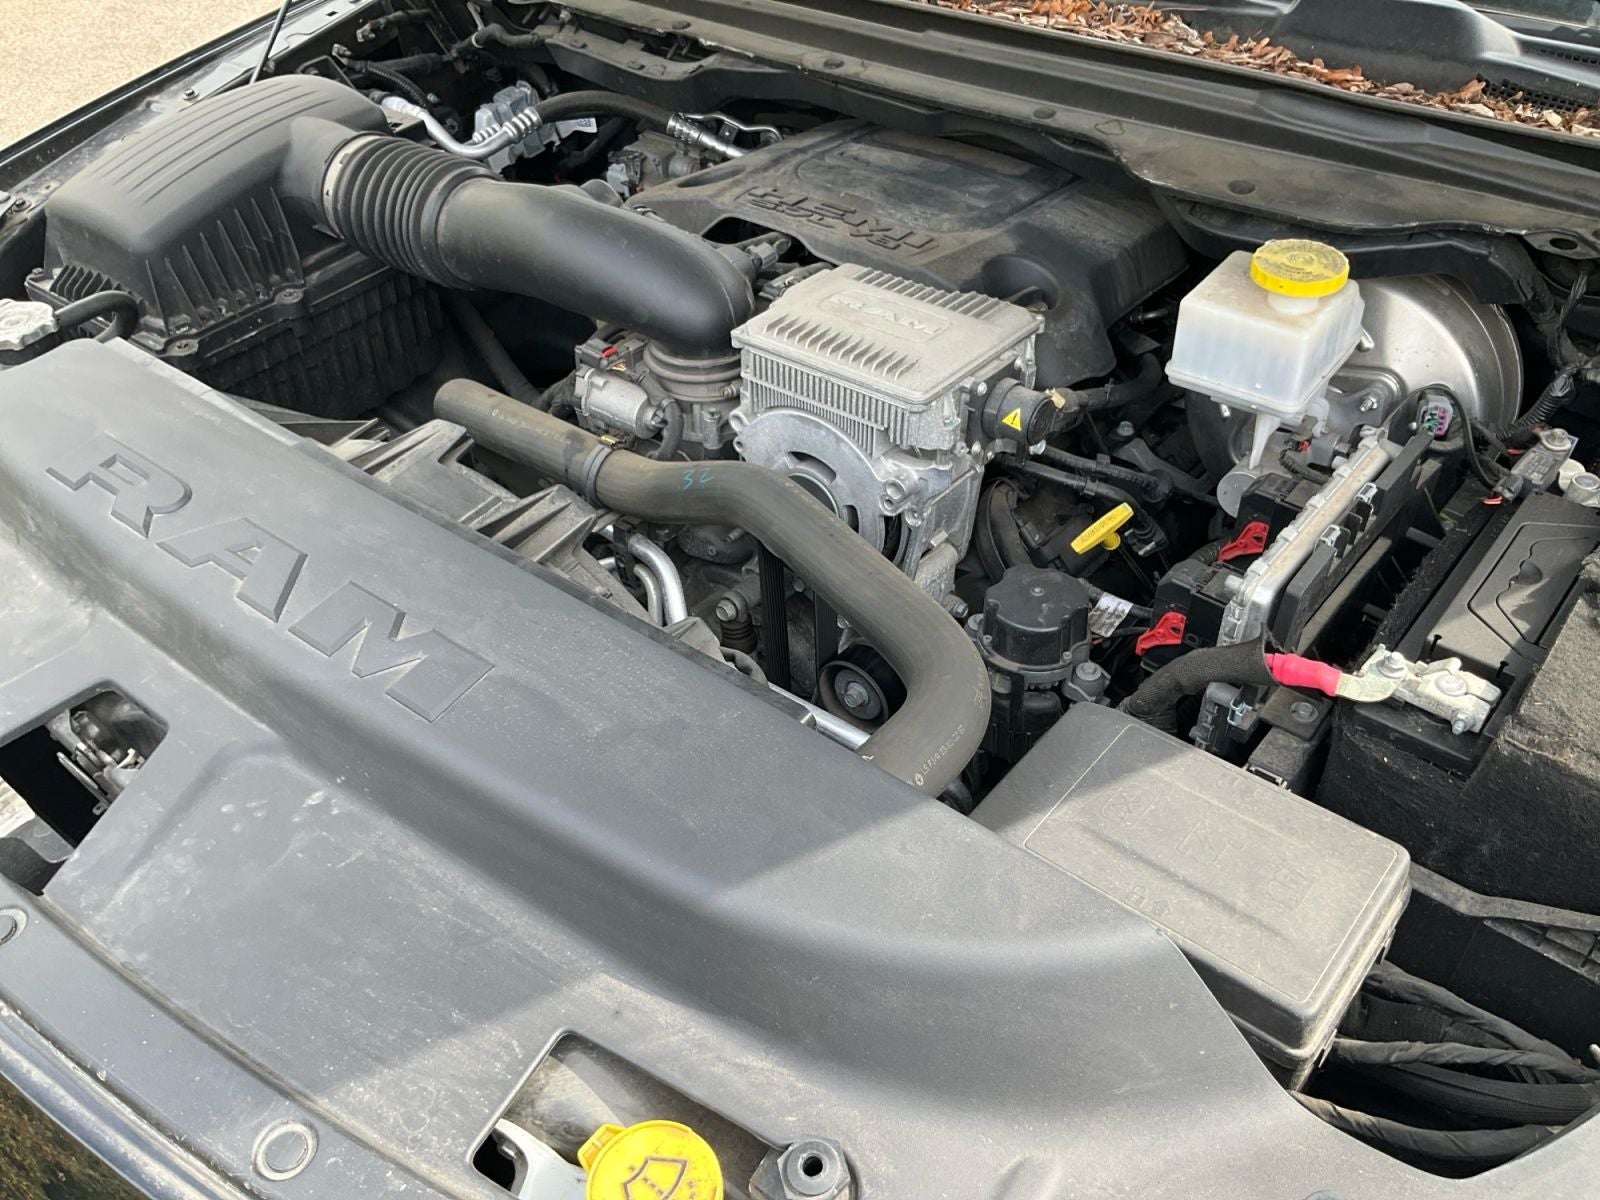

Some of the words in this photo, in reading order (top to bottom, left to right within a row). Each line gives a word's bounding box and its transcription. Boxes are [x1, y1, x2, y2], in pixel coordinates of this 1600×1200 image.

[747, 186, 935, 249] HEMI
[827, 293, 943, 335] RAM
[46, 430, 496, 723] RAM
